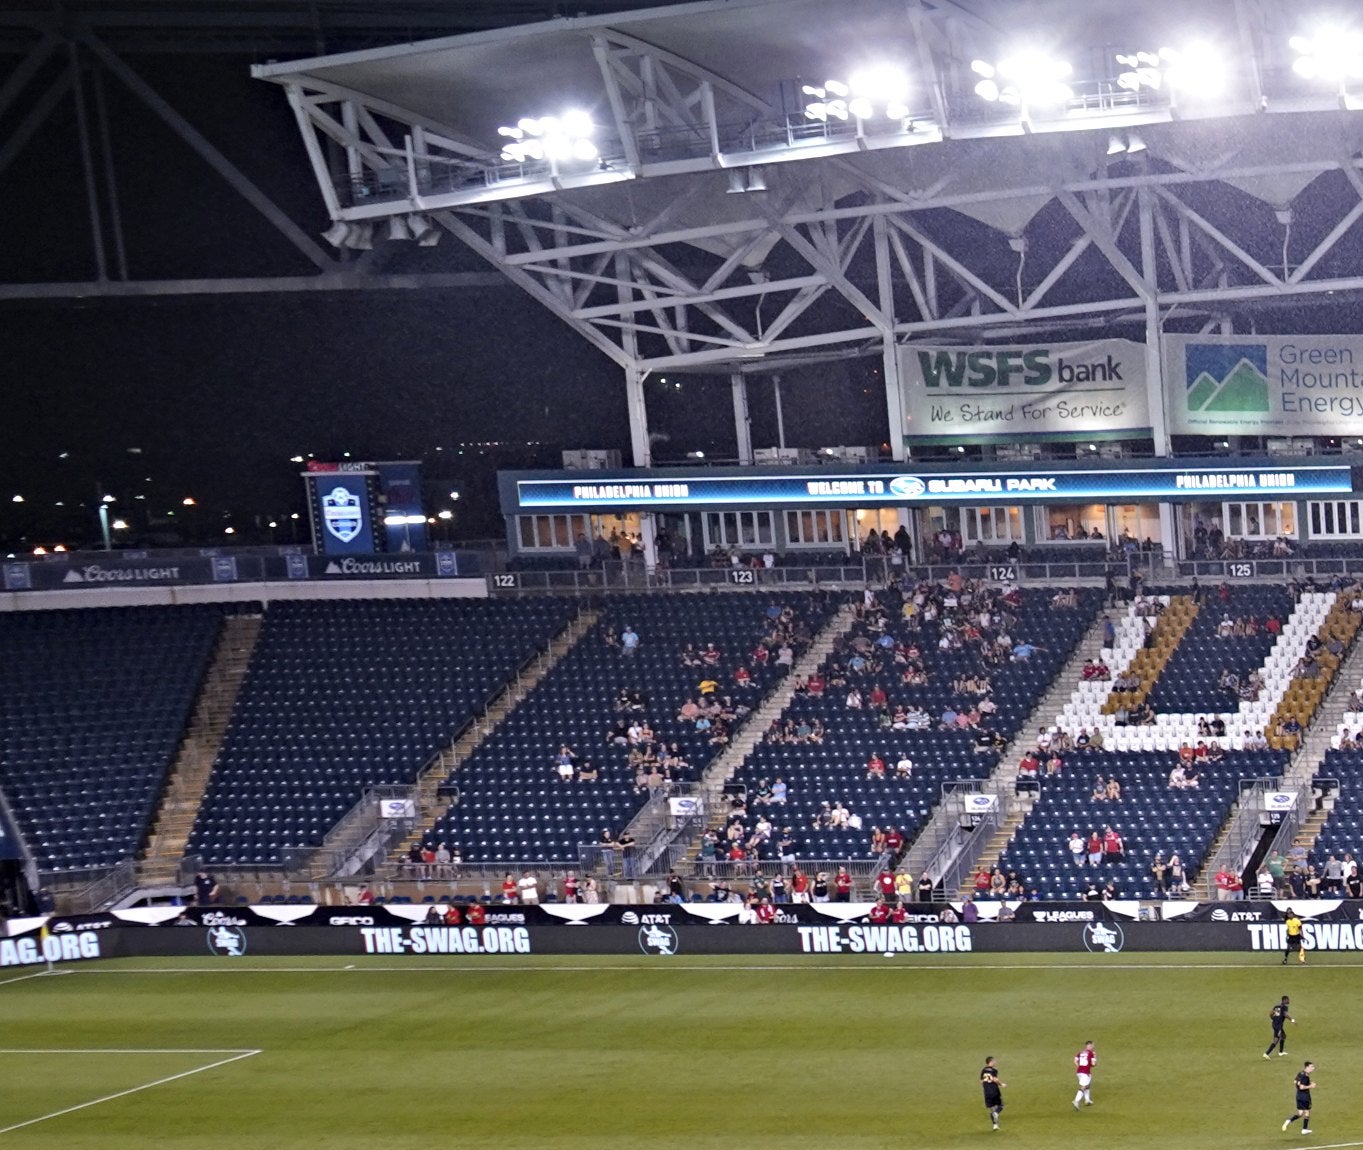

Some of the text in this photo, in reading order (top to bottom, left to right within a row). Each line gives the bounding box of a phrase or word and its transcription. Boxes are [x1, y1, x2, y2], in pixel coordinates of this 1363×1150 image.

[1280, 345, 1353, 364] Green
[918, 349, 1123, 388] WSFS bank
[930, 401, 1123, 422] We Stand For Service
[928, 477, 1056, 494] SUBARU PARK
[1176, 472, 1295, 489] PHILADELPHIA UNION
[807, 480, 884, 496] WELCOME TO
[342, 557, 420, 574] Coors LIGHT
[1230, 564, 1251, 576] 125
[84, 565, 179, 581] Coors LIGHT
[732, 571, 753, 583] 123
[991, 567, 1015, 580] 124
[494, 575, 515, 587] 122
[484, 913, 526, 923] EAGUES
[640, 914, 671, 924] AT&T
[906, 914, 939, 923] EICO
[1046, 910, 1094, 920] LEAGUES
[1230, 911, 1262, 921] AT&T
[360, 927, 530, 953] THE-SWAG.ORG
[797, 926, 972, 952] THE-SWAG.ORG
[1091, 934, 1115, 944] SWAG
